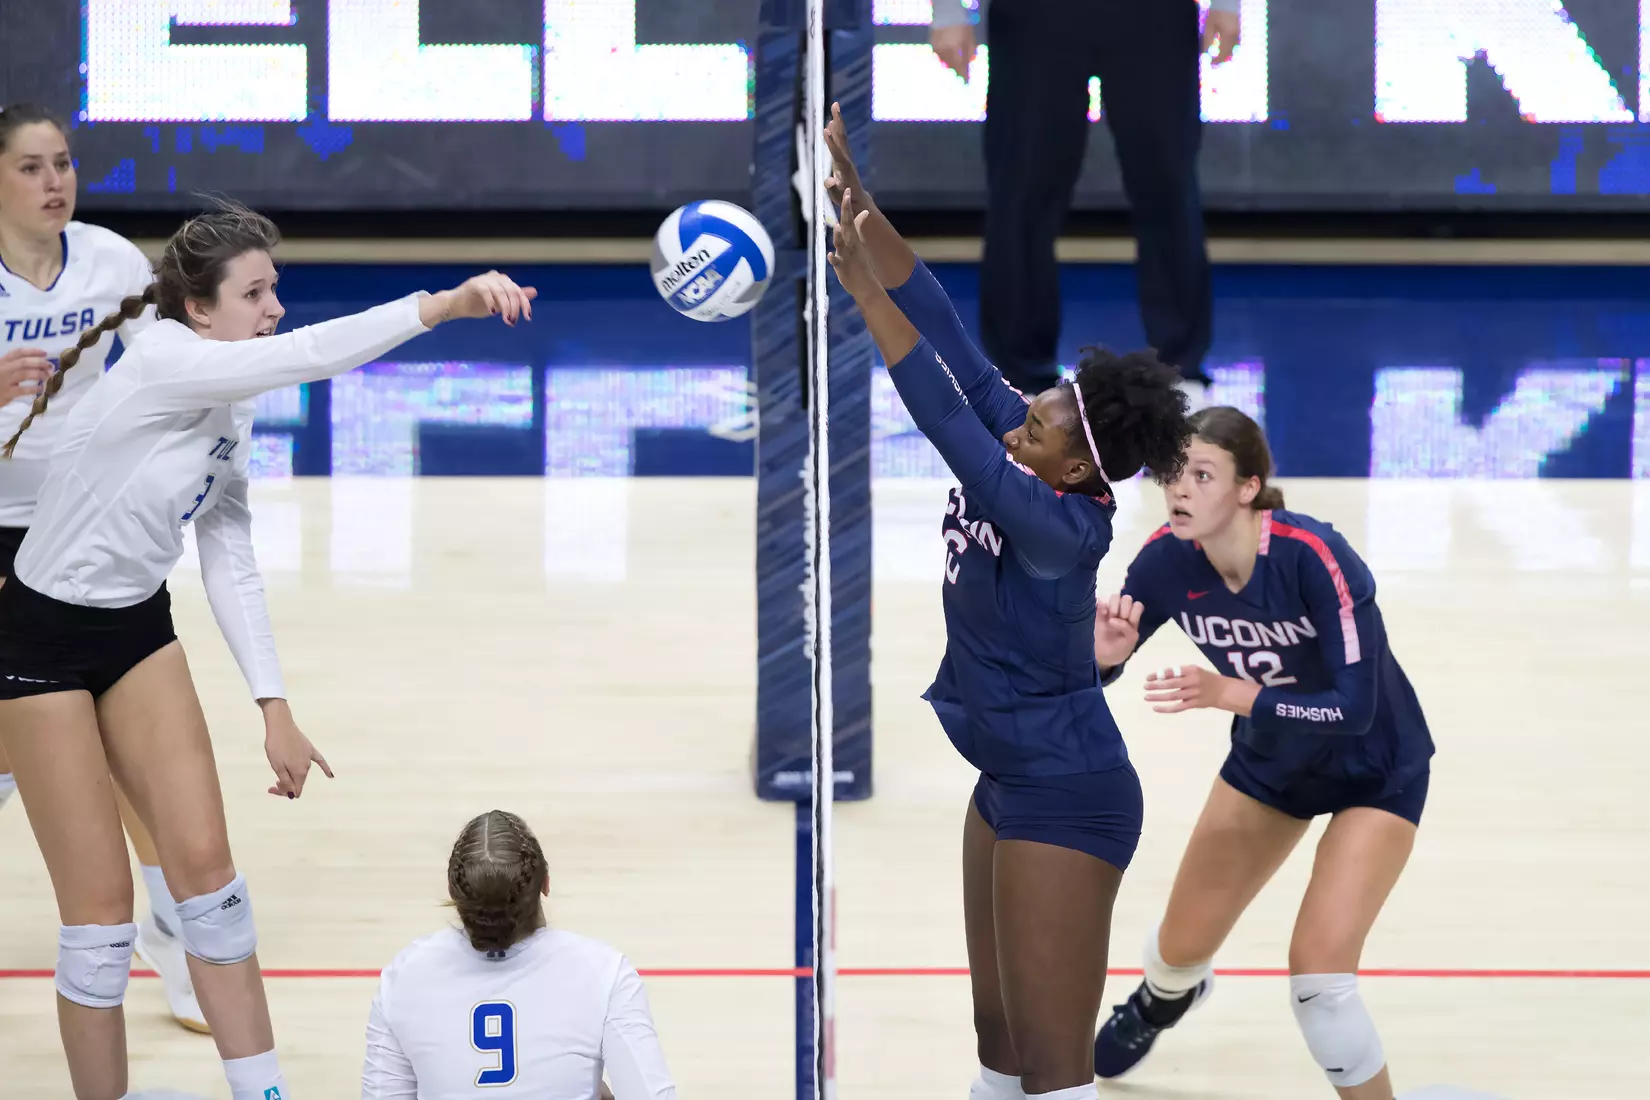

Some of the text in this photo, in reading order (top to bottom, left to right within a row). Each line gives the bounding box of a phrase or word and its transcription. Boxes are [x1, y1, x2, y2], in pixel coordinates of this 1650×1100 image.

[661, 248, 711, 293] molten
[4, 307, 95, 342] TULSA
[180, 472, 216, 523] 3
[1180, 610, 1319, 648] UCONN
[1227, 650, 1298, 688] 12
[1275, 702, 1345, 723] HUSKIES
[469, 999, 519, 1088] 9
